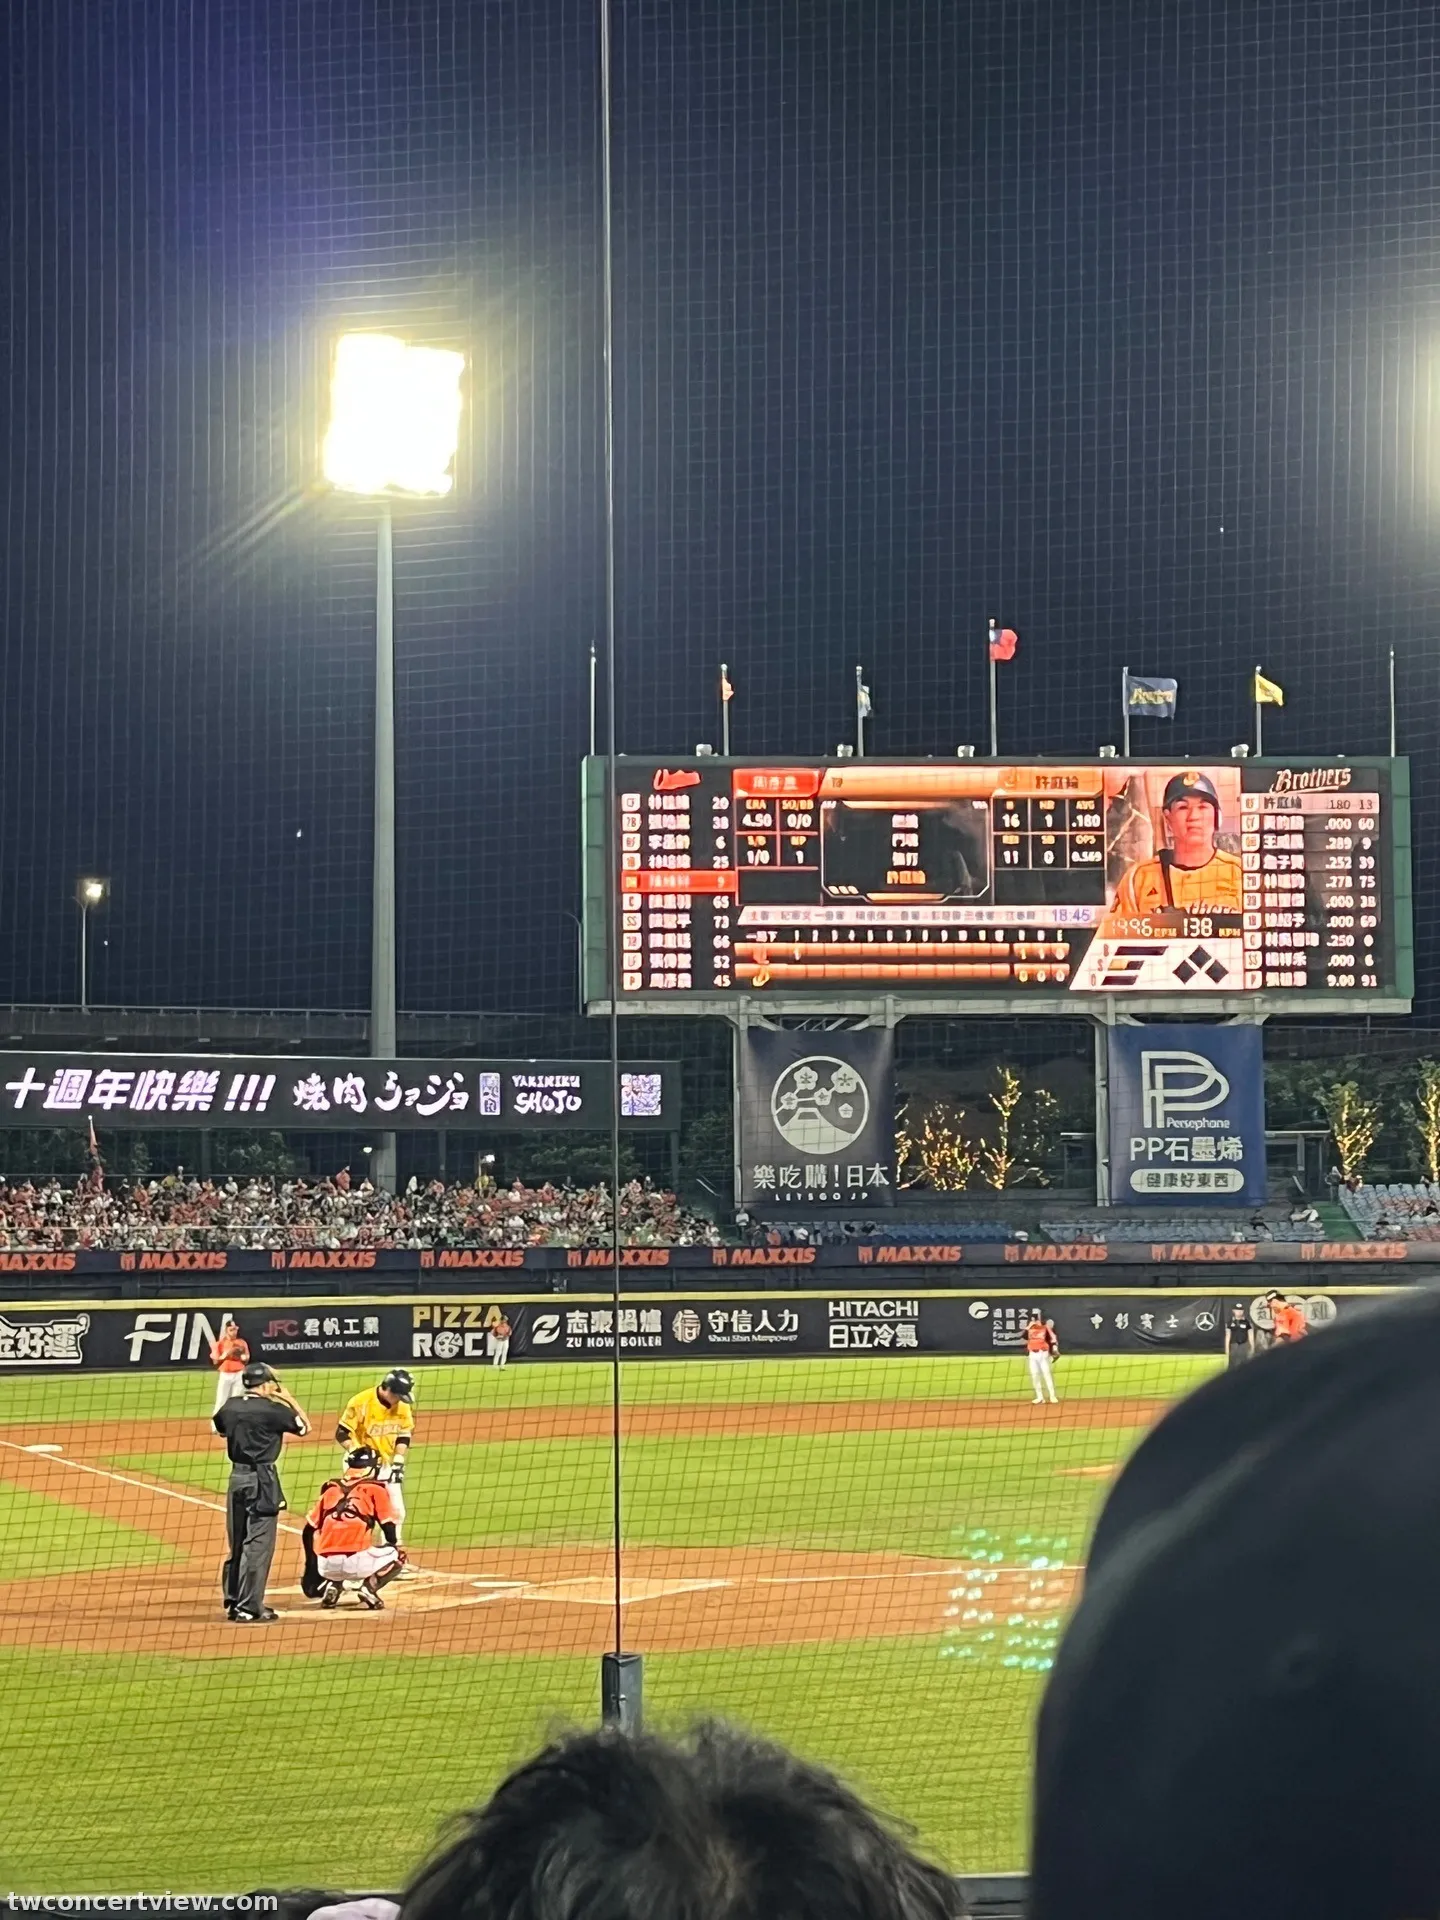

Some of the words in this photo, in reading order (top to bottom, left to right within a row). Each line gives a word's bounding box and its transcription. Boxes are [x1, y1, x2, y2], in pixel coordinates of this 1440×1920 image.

[1269, 768, 1351, 793] Brothers
[712, 796, 729, 809] 20
[1359, 799, 1373, 810] 13
[742, 814, 773, 828] 4.50
[787, 814, 812, 829] 0/0
[1002, 813, 1021, 828] 16
[1045, 813, 1053, 828] 1
[1071, 814, 1101, 828] .180
[1358, 818, 1375, 830] 60
[716, 836, 726, 849] 6
[1362, 837, 1371, 850] 9
[712, 855, 729, 869] 25
[747, 850, 770, 866] 1/0
[795, 850, 804, 864] 1
[1003, 850, 1019, 865] 11
[1044, 850, 1055, 865] 0
[1359, 856, 1375, 870] 39
[1359, 876, 1375, 888] 75
[713, 896, 729, 909] 65
[1326, 896, 1354, 908] .000
[1051, 908, 1091, 922] 18:45
[1327, 915, 1354, 928] .000
[1360, 915, 1377, 928] 69
[1111, 917, 1152, 937] 1996
[1183, 917, 1213, 938] 138
[713, 935, 730, 948] 66
[795, 930, 799, 941] 1
[1327, 935, 1355, 947] .250
[713, 955, 730, 969] 52
[1328, 954, 1355, 967] .000
[1364, 954, 1374, 967] 6
[713, 974, 731, 987] 45
[1327, 974, 1355, 987] 9.00
[1361, 974, 1377, 987] 91
[514, 1090, 582, 1114] SHOJO
[1166, 1117, 1230, 1131] Persephone
[1130, 1136, 1243, 1162] PP石墨烯
[753, 1163, 890, 1189] 樂吃購!日本
[1146, 1173, 1228, 1188] 健康好東西
[438, 1250, 524, 1267] MAXXIS
[585, 1248, 670, 1266] MAXXIS
[731, 1247, 816, 1265] MAXXIS
[876, 1246, 961, 1263] MAXXIS
[1023, 1245, 1108, 1262] MAXXIS
[1170, 1243, 1257, 1261] MAXXIS
[1320, 1242, 1408, 1260] MAXXIS
[140, 1252, 227, 1270] MAXXIS
[289, 1251, 377, 1268] MAXXIS
[829, 1300, 918, 1317] HITACHI
[413, 1305, 502, 1328] PIZZA
[708, 1309, 799, 1333] 守信人力
[263, 1319, 300, 1338] JFC
[829, 1323, 918, 1348] 日立冷氣
[566, 1337, 582, 1348] ZU
[620, 1336, 662, 1347] BOILER
